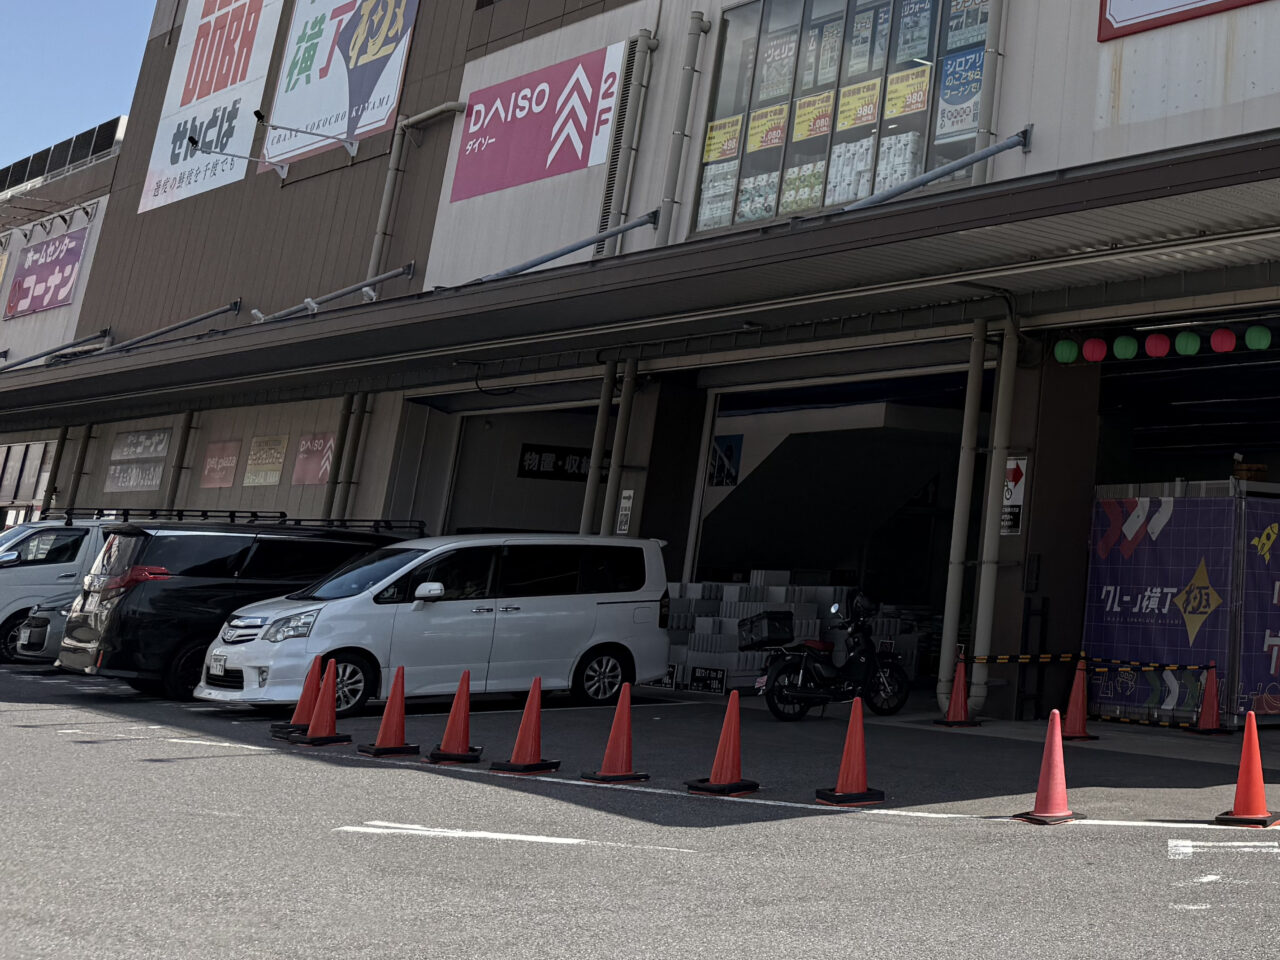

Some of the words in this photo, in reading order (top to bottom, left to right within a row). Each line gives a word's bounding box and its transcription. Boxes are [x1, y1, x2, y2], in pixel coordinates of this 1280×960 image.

[901, 0, 930, 16] リフォーム
[284, 0, 358, 94] 横丁
[945, 51, 984, 74] シロアリ
[469, 82, 550, 134] DAISO
[595, 71, 617, 136] 2F
[857, 104, 873, 117] 980
[906, 91, 923, 105] 980
[169, 97, 242, 166] せんどば
[466, 136, 496, 155] ダイソー
[24, 233, 76, 270] ホームセンター
[17, 261, 80, 312] コーナン
[300, 439, 323, 451] DAISO
